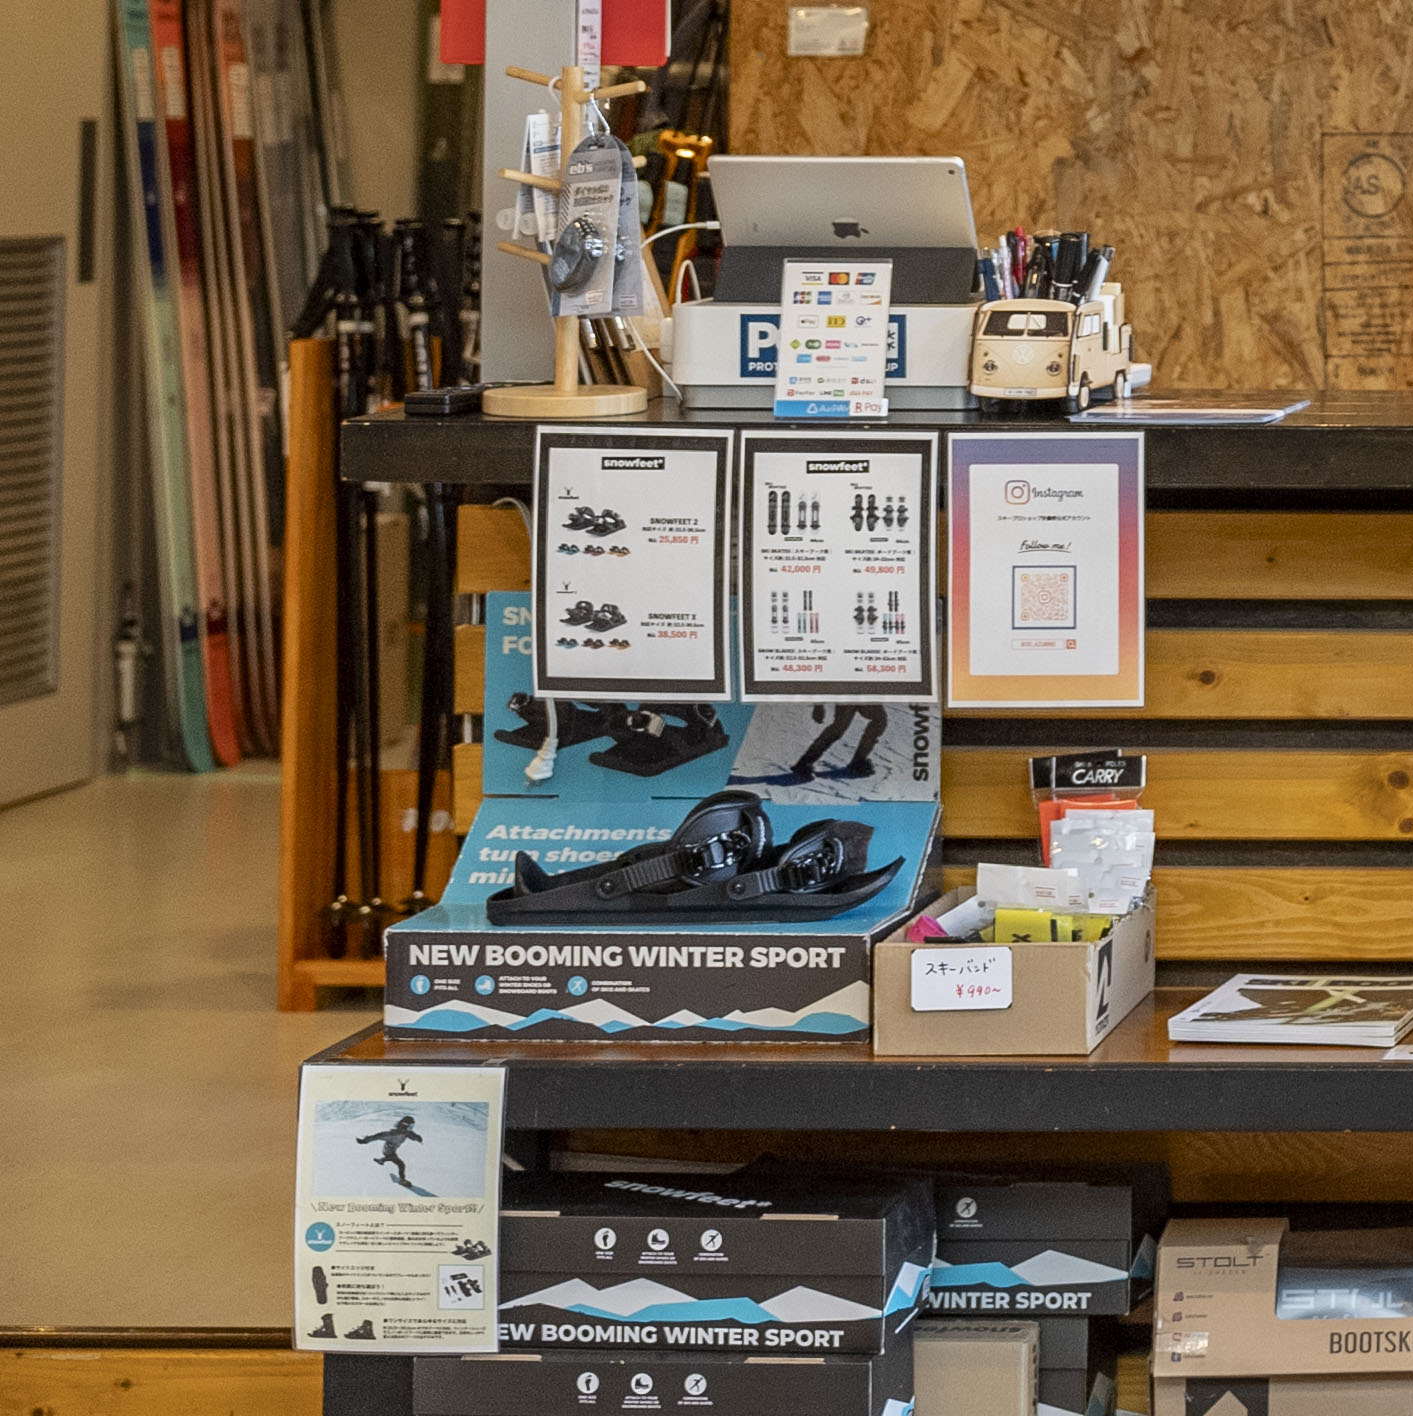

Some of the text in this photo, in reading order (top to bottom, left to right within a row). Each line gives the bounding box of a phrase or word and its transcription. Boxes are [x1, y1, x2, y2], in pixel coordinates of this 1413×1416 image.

[1031, 487, 1084, 502] Instagram
[1071, 768, 1125, 784] CARRY
[486, 823, 671, 842] Attachments
[477, 846, 540, 864] turn
[409, 944, 846, 969] NEW BOOMING WINTER SPORT
[925, 956, 997, 976] スキーバンド
[1176, 1254, 1264, 1269] STOLT
[1015, 1291, 1093, 1310] SPORT
[541, 1323, 845, 1348] BOOMING WINTER SPORT
